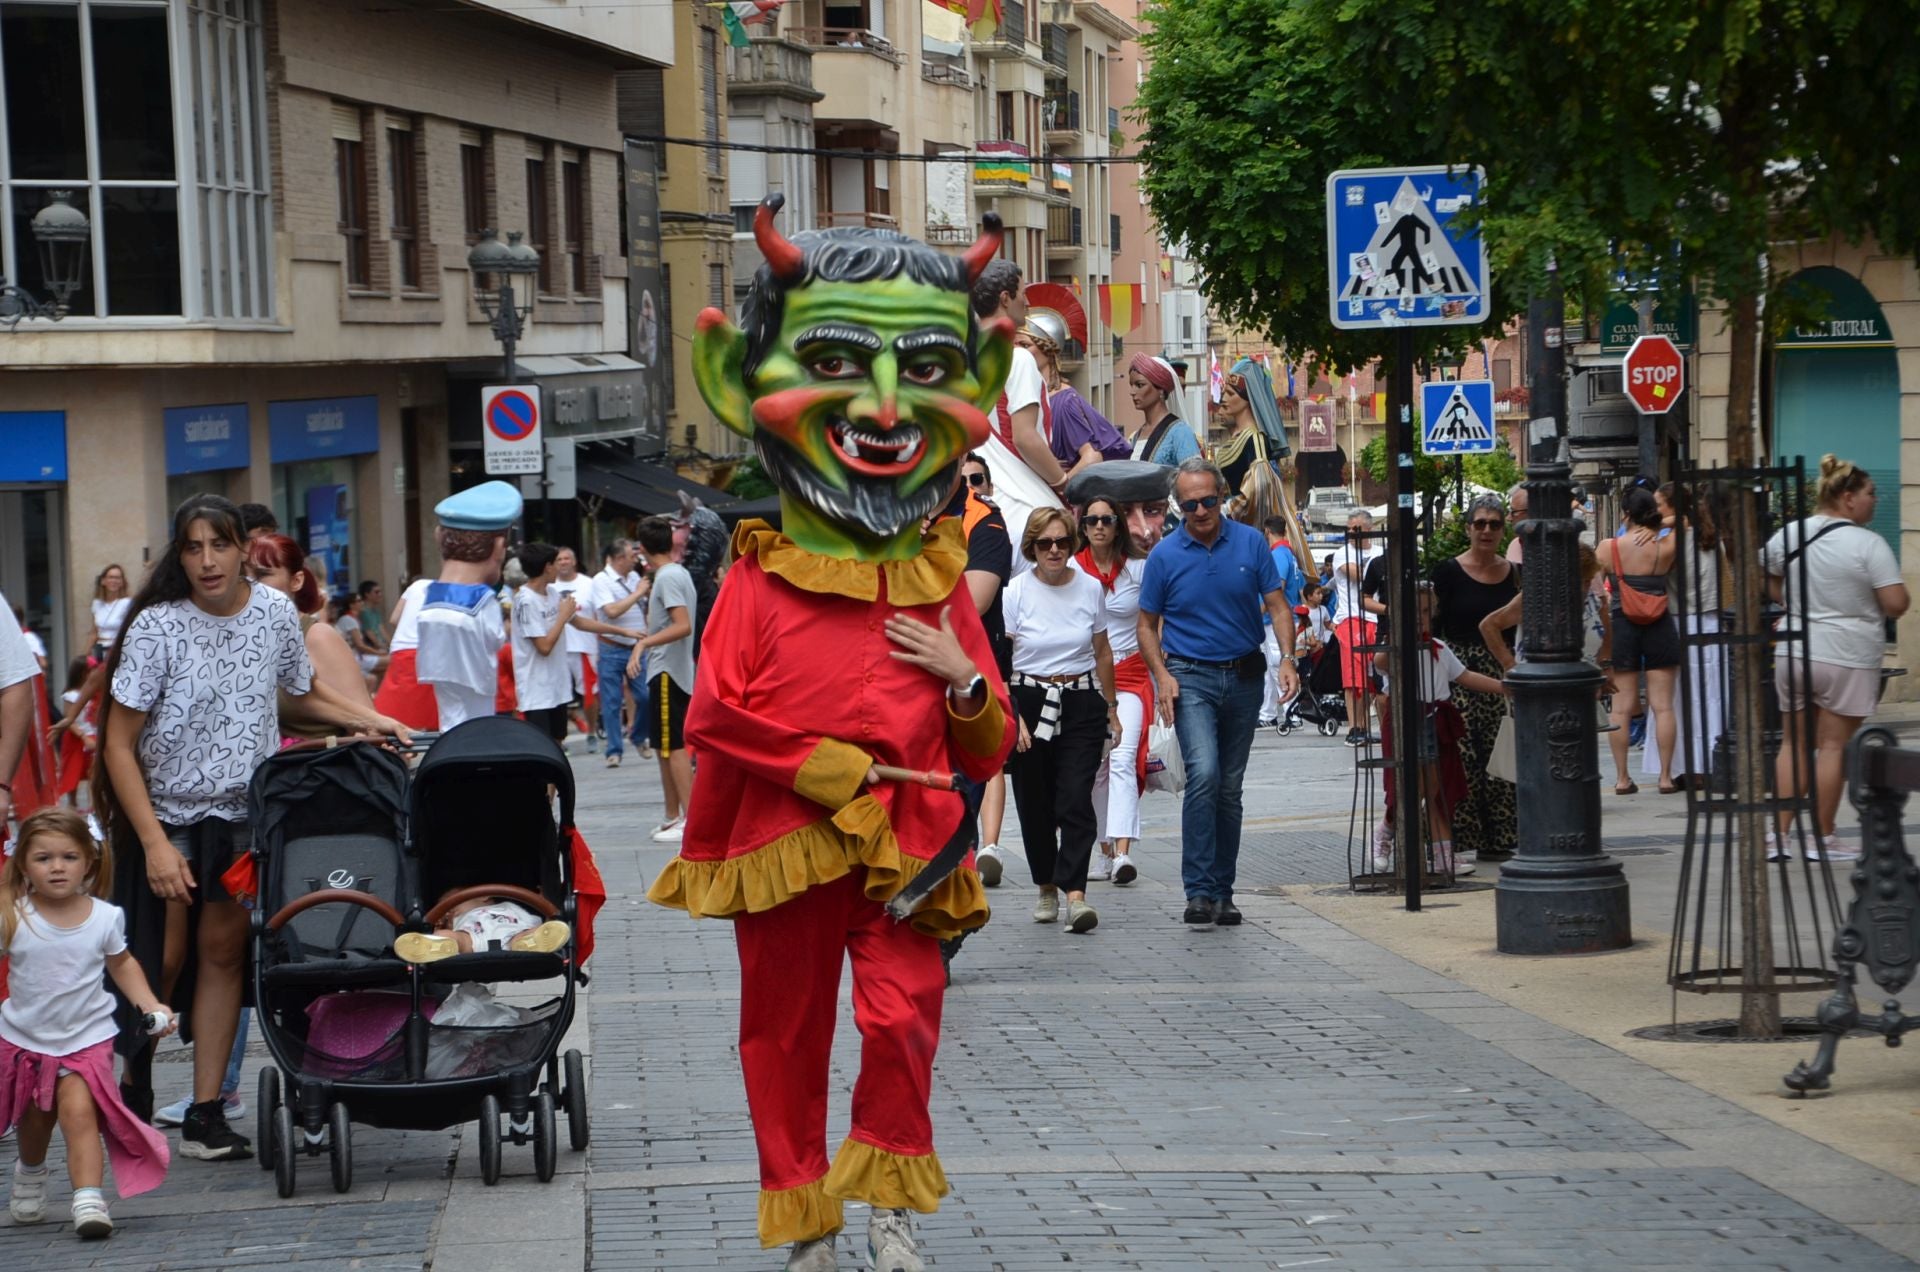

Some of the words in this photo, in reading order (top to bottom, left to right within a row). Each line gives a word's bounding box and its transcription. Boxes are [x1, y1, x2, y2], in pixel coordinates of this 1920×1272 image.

[1831, 320, 1879, 337] RURAL
[1611, 334, 1627, 343] DE
[1632, 365, 1678, 385] STOP
